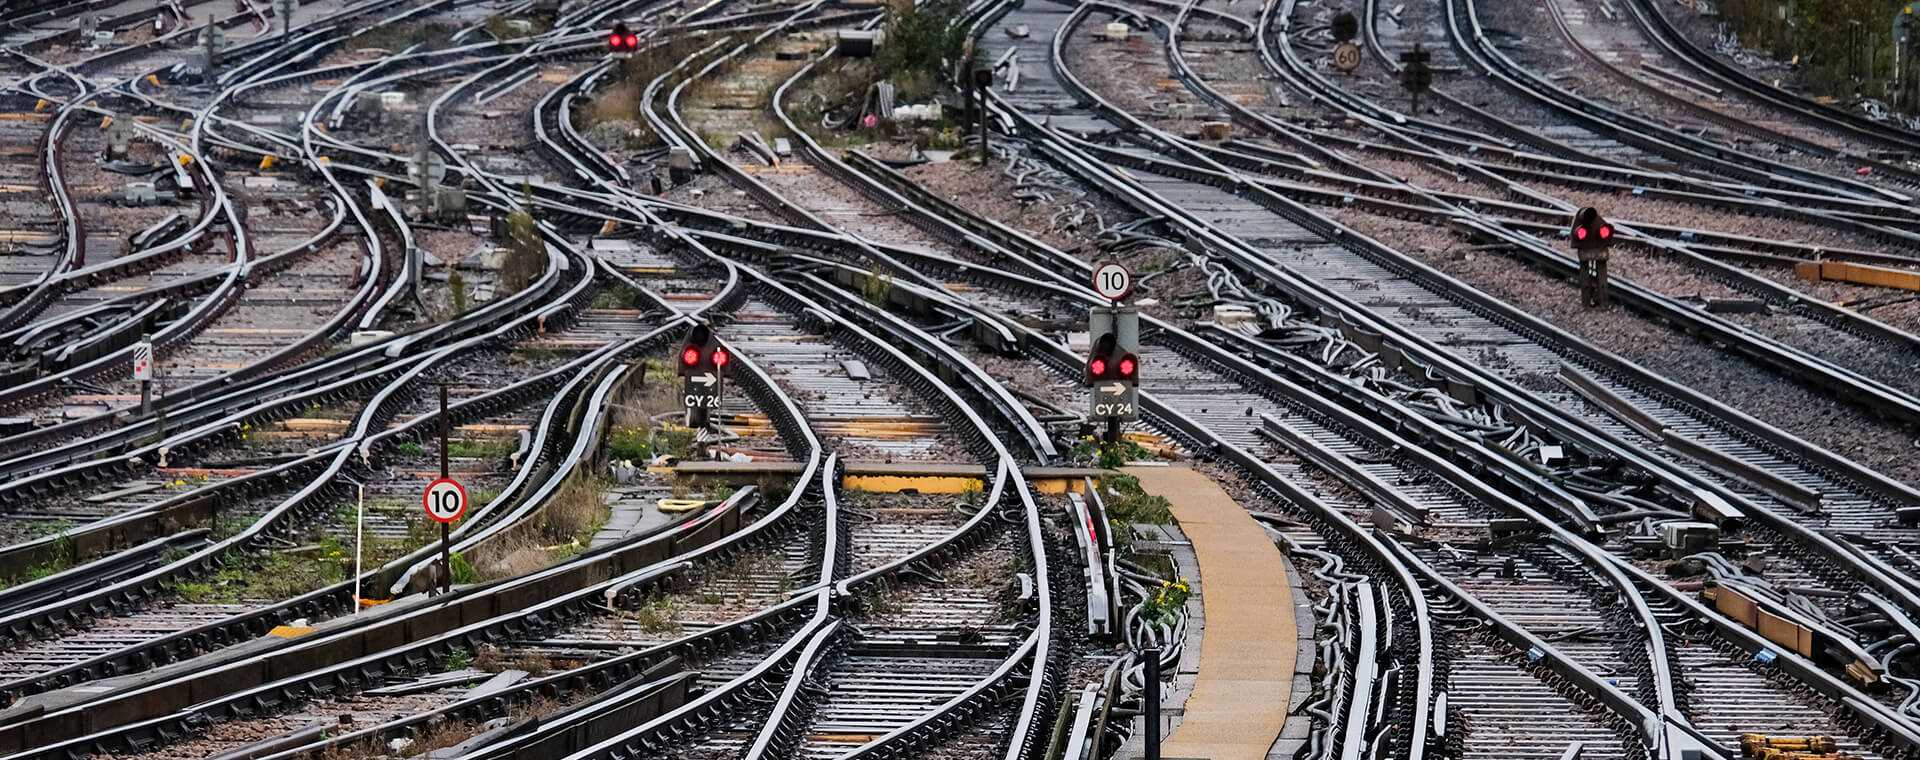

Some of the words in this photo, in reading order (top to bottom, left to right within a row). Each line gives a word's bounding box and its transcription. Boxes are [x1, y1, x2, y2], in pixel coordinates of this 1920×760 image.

[1339, 50, 1357, 64] 60
[1102, 272, 1125, 291] 10
[685, 394, 704, 407] CY
[1095, 403, 1114, 415] CY
[1116, 403, 1133, 415] 24
[432, 490, 459, 513] 10
